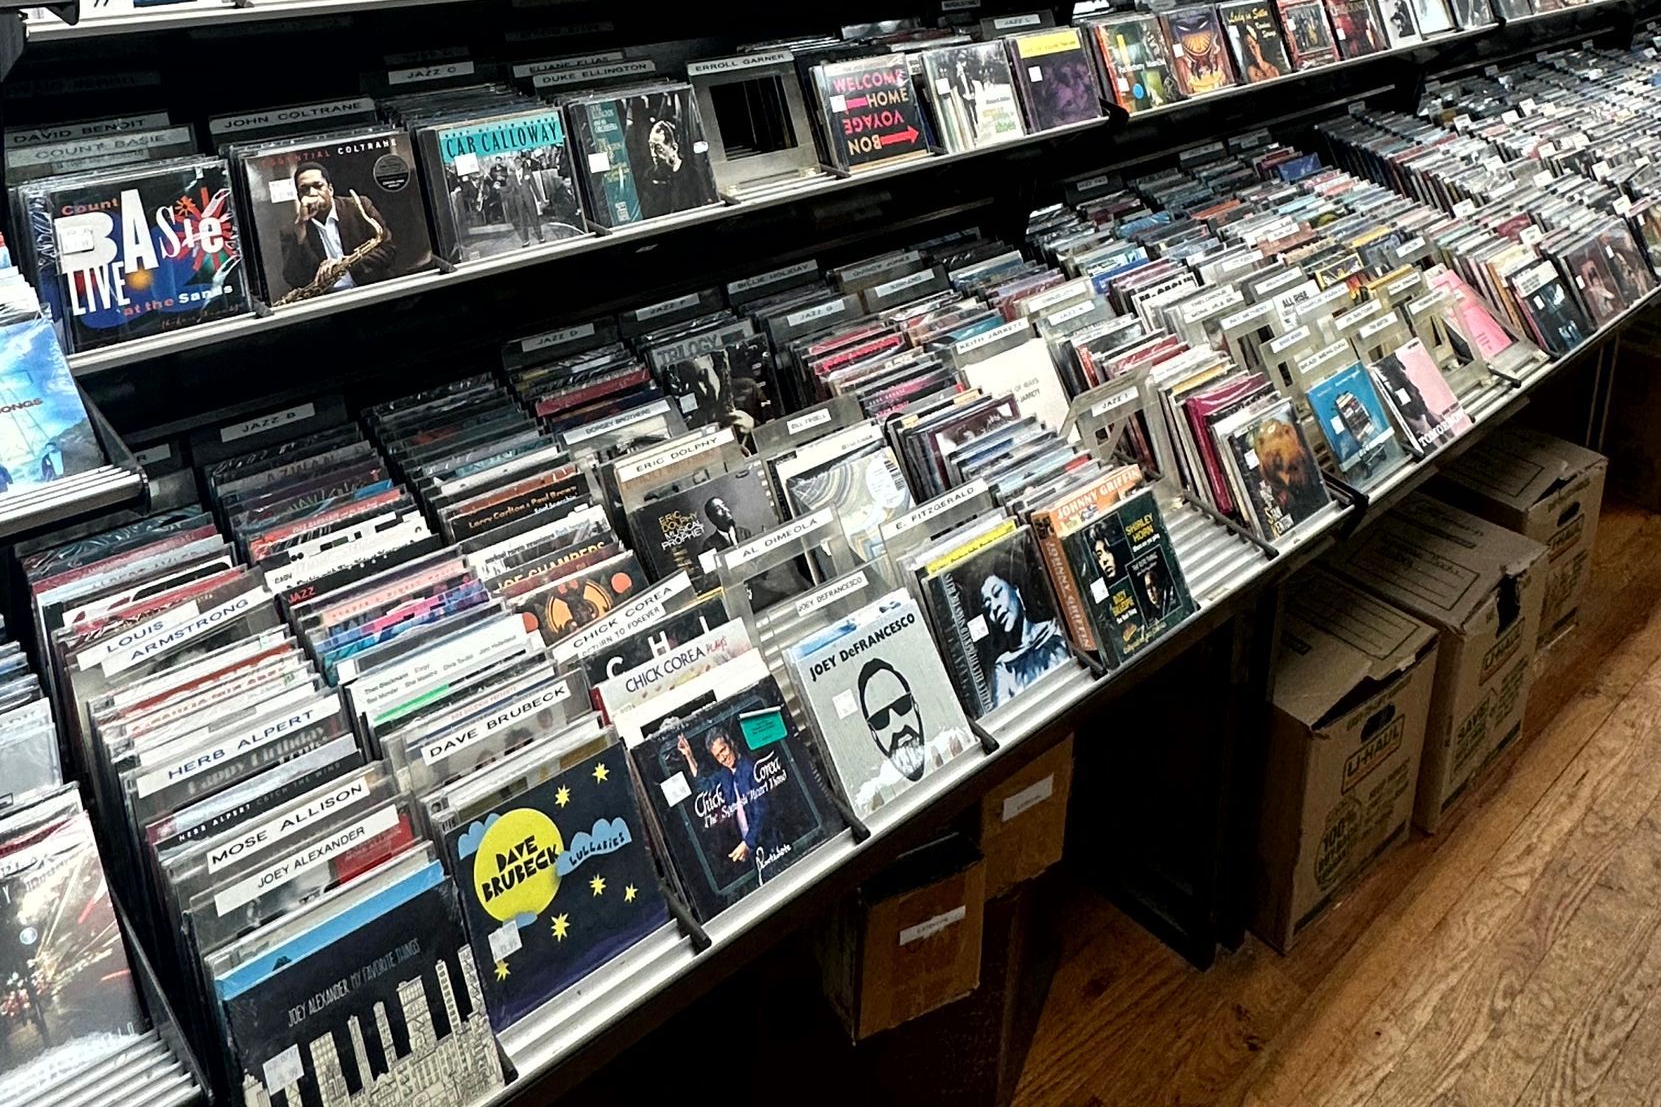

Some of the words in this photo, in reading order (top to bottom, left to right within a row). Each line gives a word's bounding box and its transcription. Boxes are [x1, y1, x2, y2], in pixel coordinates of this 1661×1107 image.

[407, 68, 441, 79] JAZZ
[542, 72, 577, 84] DUKE
[582, 63, 647, 78] ELLINGTON
[696, 59, 738, 72] ERROLL
[743, 53, 785, 65] GARNER
[833, 69, 905, 93] WELCOME
[867, 86, 909, 108] HOME
[223, 115, 269, 129] JOHN
[277, 101, 363, 121] COLTRANE
[14, 129, 72, 143] DAVID
[81, 119, 146, 134] BENOIT
[446, 135, 476, 159] CAB
[481, 121, 559, 153] CALLOWAY
[35, 143, 106, 160] COUNT
[114, 133, 166, 148] BASIE
[337, 138, 398, 156] COLTRANE
[62, 197, 119, 216] Count
[63, 259, 131, 317] LIVE
[145, 296, 174, 313] the
[651, 302, 675, 314] JAZZ
[537, 333, 564, 345] JAZZ
[243, 416, 281, 433] JAZZ
[636, 456, 664, 472] ERIC
[671, 436, 718, 458] DOLPHY
[1057, 493, 1099, 520] JOHNNY
[1099, 467, 1142, 497] GRIFFIN
[895, 519, 907, 530] E.
[911, 486, 975, 522] FITZGERALD
[661, 526, 705, 551] PROPHET
[742, 546, 759, 558] AL
[765, 517, 818, 547] DIMEOLA
[287, 584, 316, 606] JAZZ
[131, 597, 250, 662] ARMSTRONG
[572, 618, 618, 649] CHICK
[624, 585, 673, 617] COREA
[106, 619, 164, 653] LOUIS
[625, 664, 662, 693] CHICK
[663, 646, 707, 675] COREA
[809, 656, 838, 682] JOEY
[429, 727, 479, 758] DAVE
[486, 686, 566, 730] BRUBECK
[167, 748, 228, 781] HERB
[236, 709, 313, 751] ALPERT
[212, 830, 269, 865] MOSE
[280, 783, 363, 833] ALLISON
[258, 865, 290, 889] JOEY
[293, 826, 366, 871] ALEXANDER
[496, 835, 538, 871] DAVE
[481, 844, 561, 903] BRUBECK
